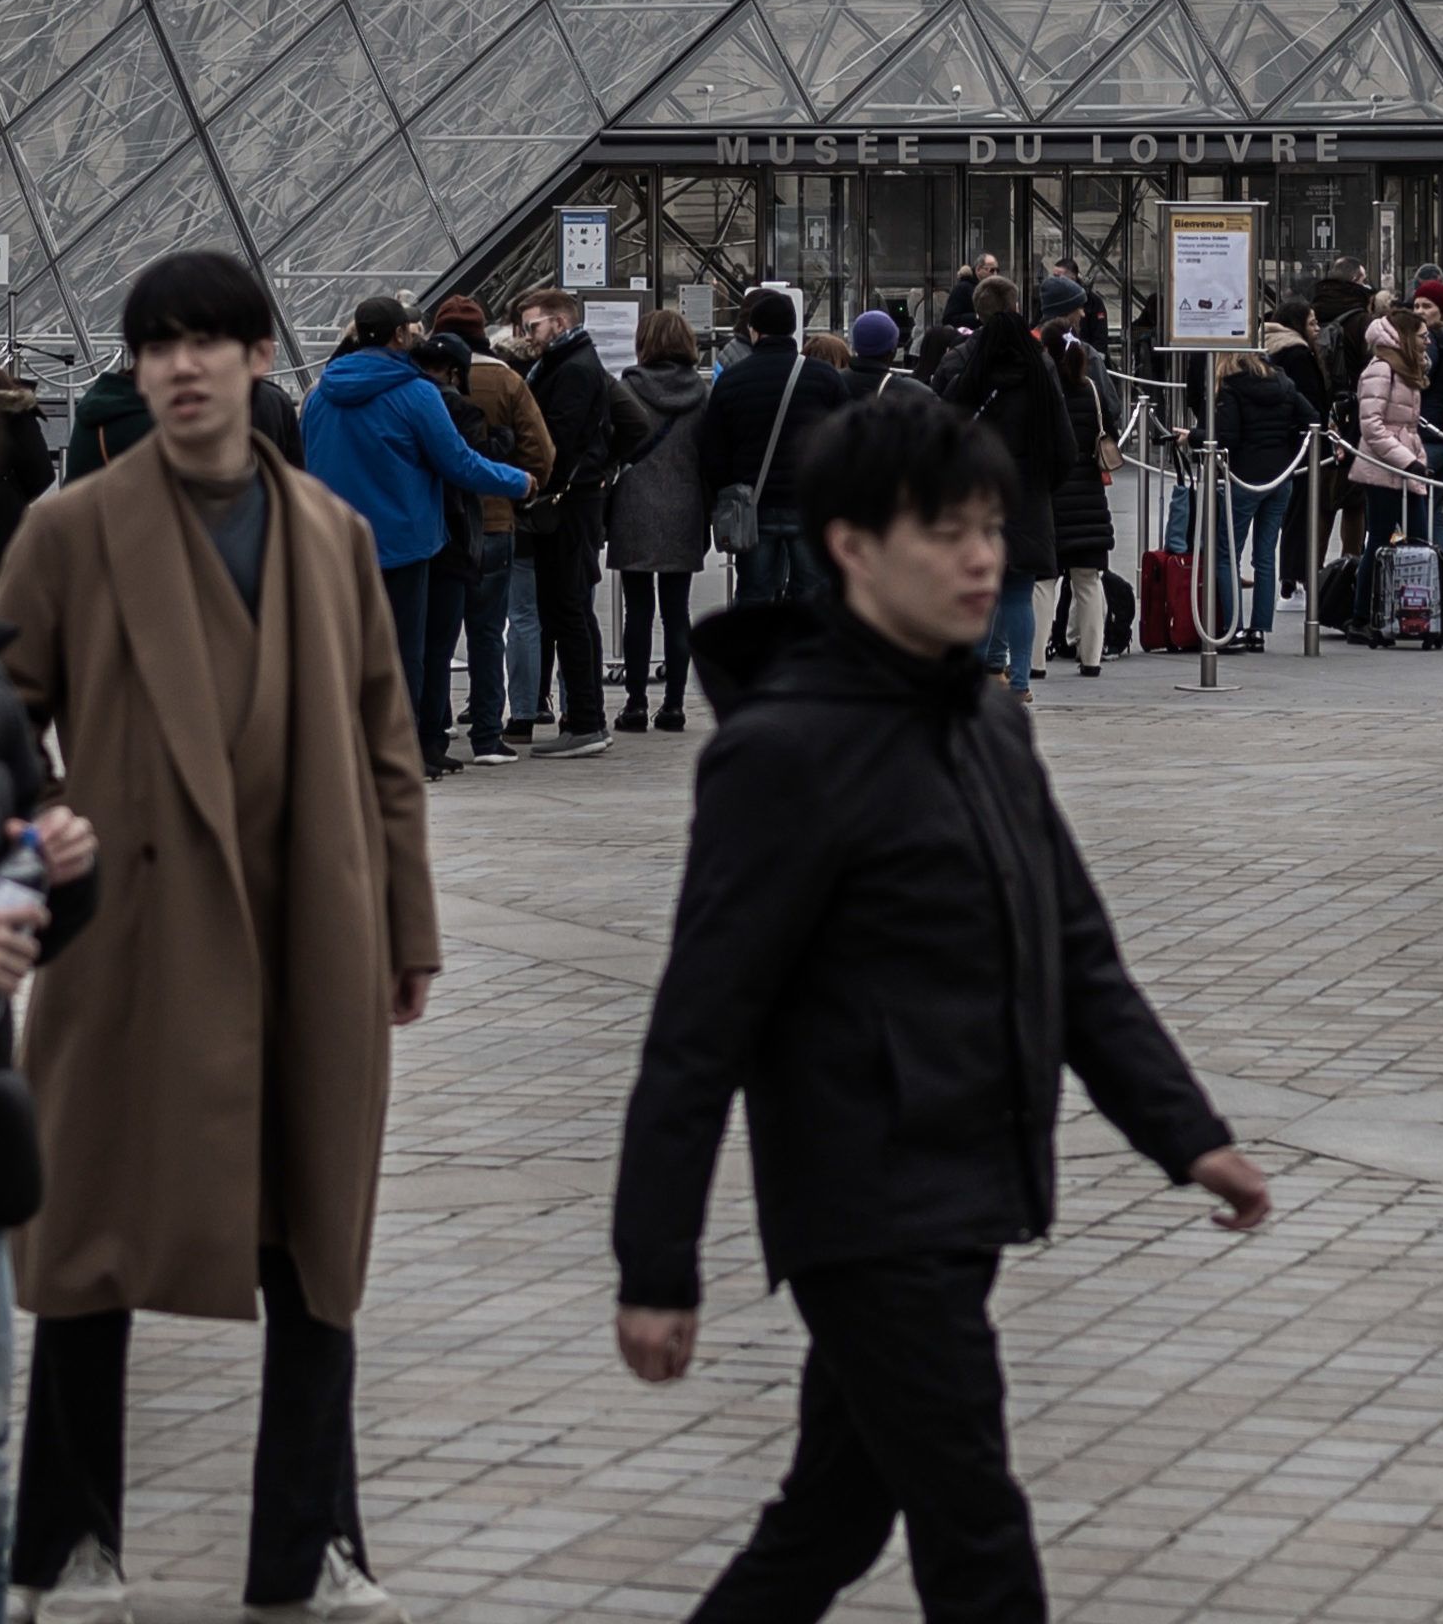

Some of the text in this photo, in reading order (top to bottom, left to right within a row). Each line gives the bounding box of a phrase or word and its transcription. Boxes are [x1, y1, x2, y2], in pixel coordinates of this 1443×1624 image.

[716, 129, 1339, 165] MUSÉE DU LOUVRE
[1173, 219, 1225, 229] Bienvenue
